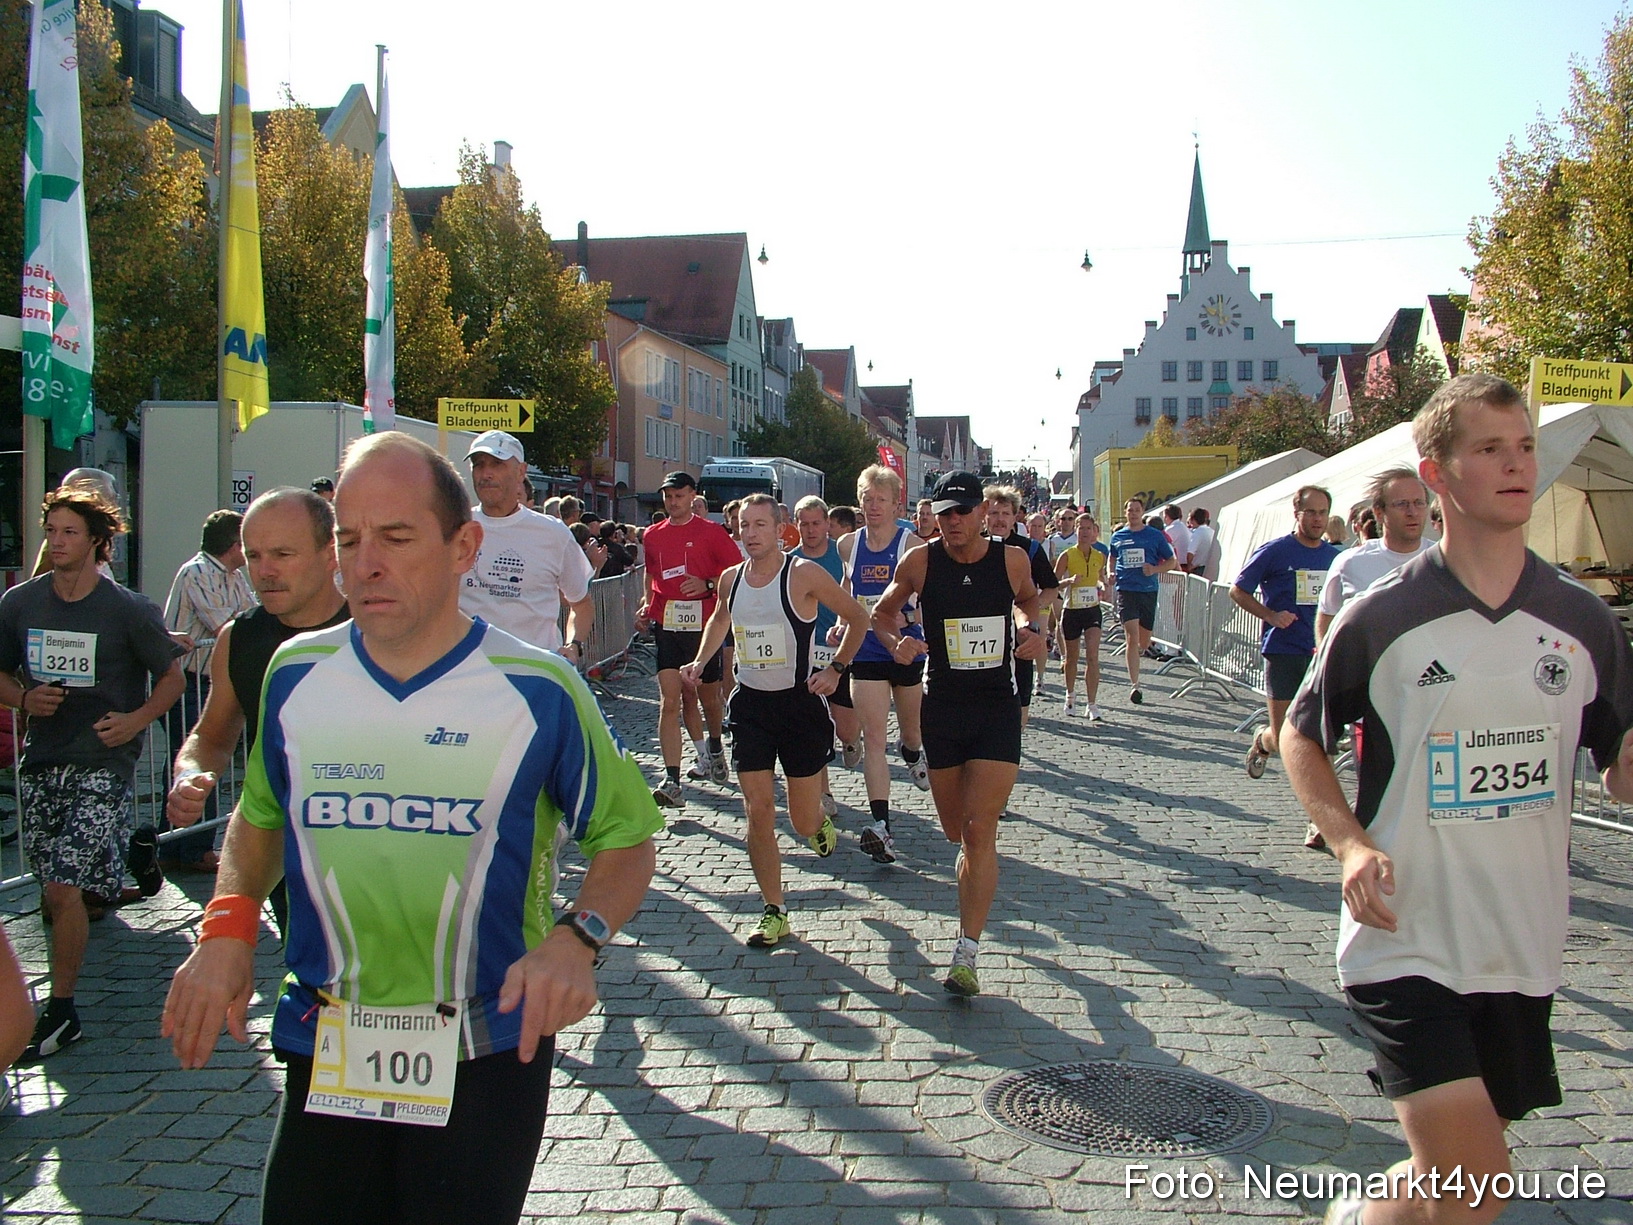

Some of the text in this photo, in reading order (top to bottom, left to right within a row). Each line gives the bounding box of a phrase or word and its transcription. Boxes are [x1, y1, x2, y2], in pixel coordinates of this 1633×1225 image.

[1543, 362, 1611, 381] Treffpunkt
[1541, 382, 1613, 402] Bladenight
[446, 401, 509, 414] Treffpunkt
[446, 416, 513, 430] Bladenight
[492, 565, 525, 574] 16.09.2007
[466, 578, 522, 592] 8. Neumarkter
[489, 588, 521, 598] Stadtlauf
[677, 614, 697, 623] 300
[745, 629, 765, 638] Horst
[961, 622, 983, 633] Klaus
[46, 635, 86, 649] Benjamin
[968, 639, 997, 655] 717
[756, 644, 773, 657] 18
[46, 654, 89, 672] 3218
[1417, 673, 1456, 687] adidas
[1465, 728, 1545, 748] Johannes
[312, 763, 385, 780] TEAM
[1434, 760, 1443, 775] A
[1469, 758, 1549, 794] 2354
[302, 791, 484, 837] BOCK
[1431, 807, 1481, 820] BOCK
[350, 1004, 437, 1031] Hermann
[321, 1035, 330, 1053] A
[366, 1050, 433, 1086] 100
[308, 1093, 365, 1110] BOCK
[396, 1102, 448, 1117] PFLEIDERER
